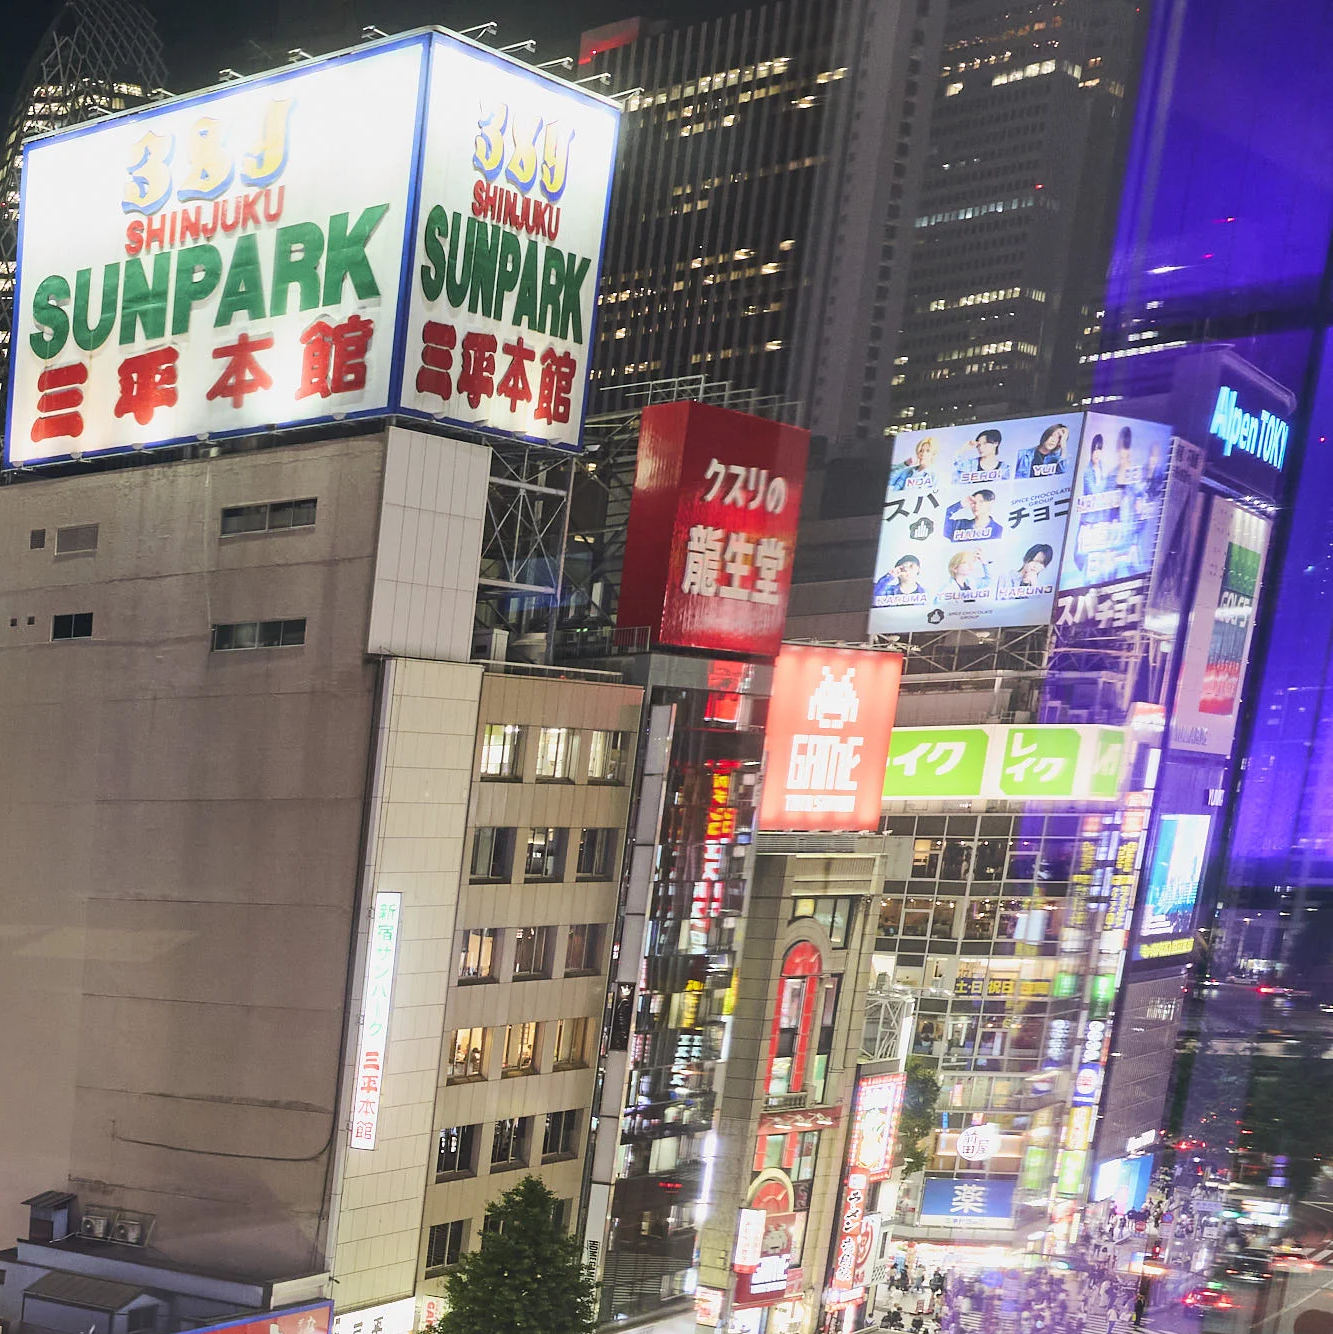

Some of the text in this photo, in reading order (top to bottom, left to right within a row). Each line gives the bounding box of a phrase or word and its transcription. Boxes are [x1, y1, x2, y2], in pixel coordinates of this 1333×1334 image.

[123, 185, 285, 254] SHINJUKU
[471, 180, 561, 243] SHINJUKU
[29, 204, 389, 360] SUNPARK
[420, 204, 591, 345] SUNPARK
[30, 313, 375, 443] 三平本館
[415, 319, 578, 427] 三平本館
[1209, 385, 1257, 457] Alpen
[703, 456, 787, 515] クスリの
[1030, 487, 1071, 501] CHOCOLATE
[1033, 464, 1057, 476] YUI
[884, 489, 941, 523] スパ
[1028, 497, 1054, 507] GROUP
[680, 523, 787, 606] 龍生堂
[954, 528, 993, 541] HAKU
[786, 734, 864, 790] GAME
[949, 1183, 988, 1214] 薬
